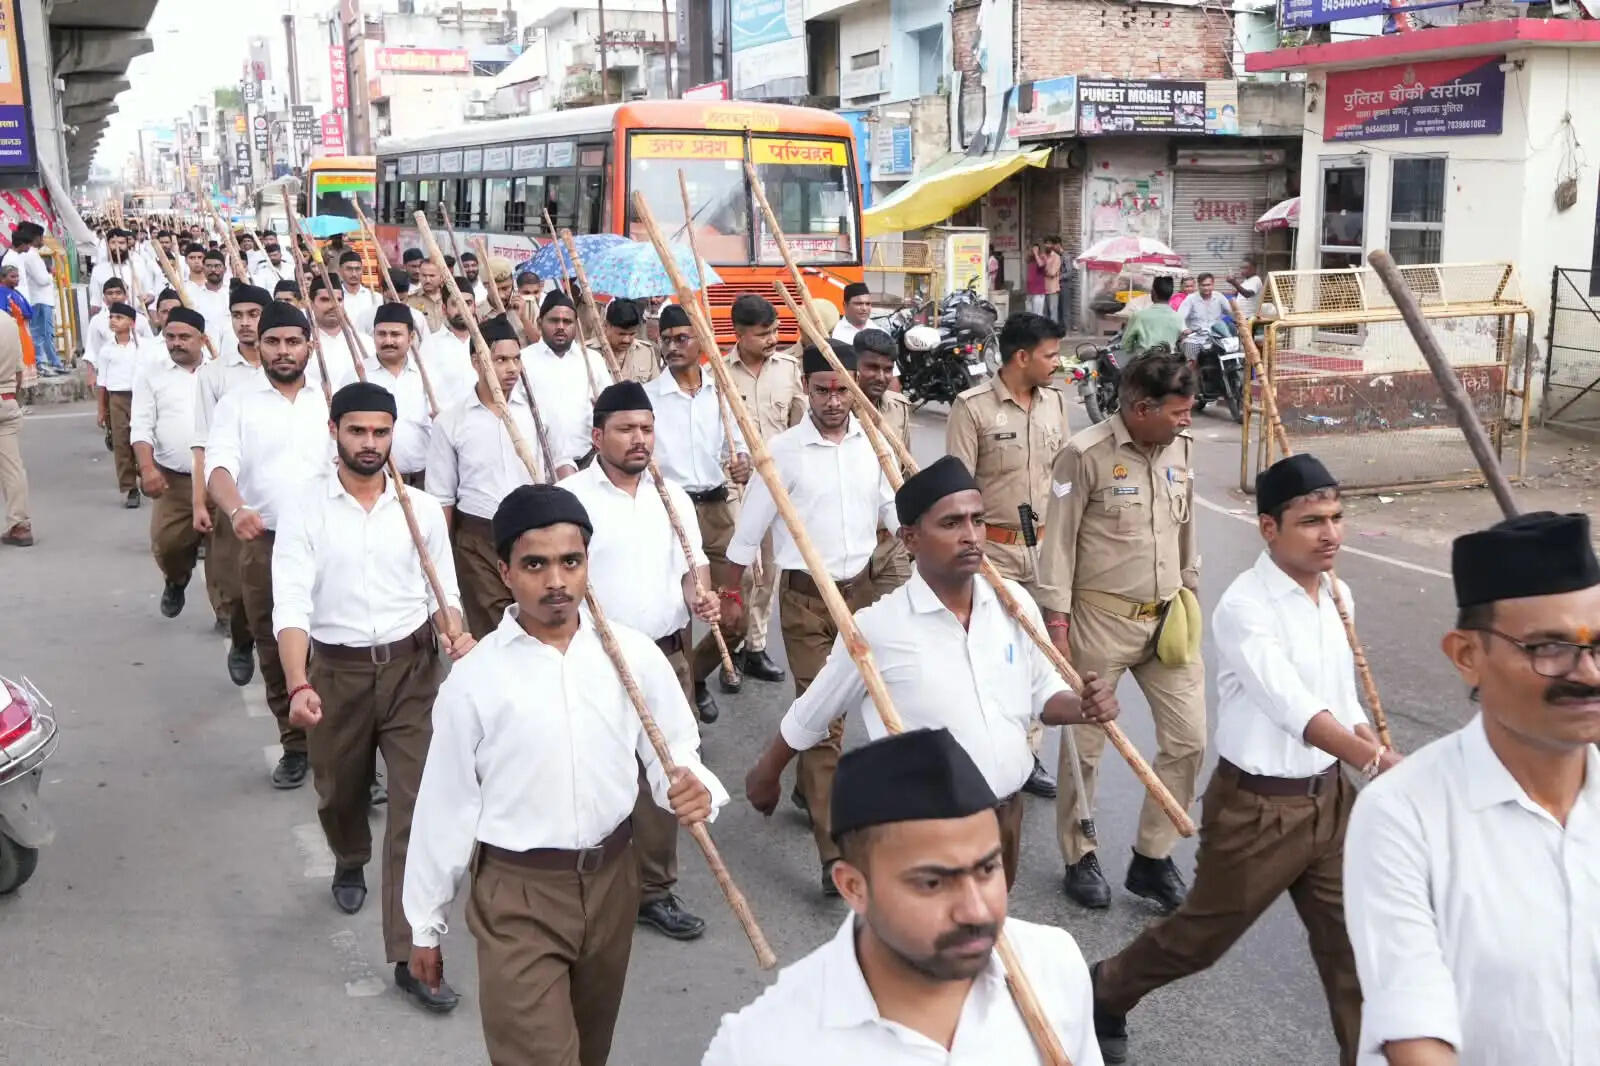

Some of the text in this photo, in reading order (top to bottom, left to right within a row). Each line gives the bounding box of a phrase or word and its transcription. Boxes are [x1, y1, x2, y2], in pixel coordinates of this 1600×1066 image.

[1080, 88, 1204, 104] PUNEET MOBILE CARE
[1344, 78, 1482, 111] पुलिस चौकी सर्राफा
[1441, 101, 1464, 116] पुलिस
[767, 141, 835, 163] परिवहन
